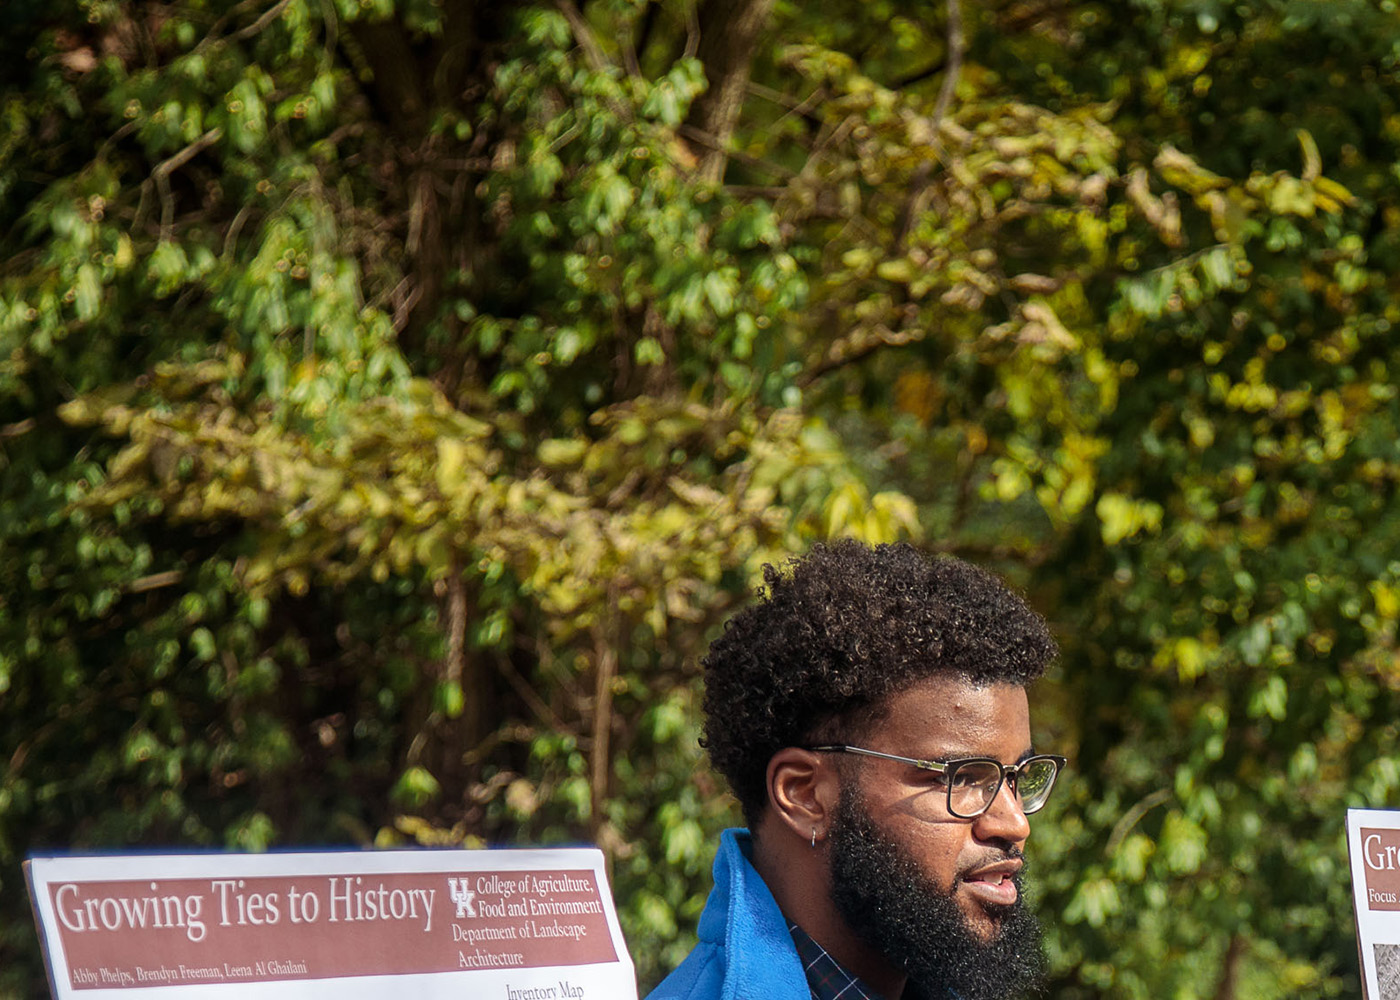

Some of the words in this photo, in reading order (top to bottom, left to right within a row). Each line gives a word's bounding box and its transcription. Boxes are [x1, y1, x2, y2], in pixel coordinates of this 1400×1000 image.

[476, 875, 516, 898] College
[518, 876, 530, 894] of
[531, 874, 594, 896] Agriculture,
[1368, 888, 1396, 903] Focus
[55, 882, 206, 942] Growing
[211, 880, 281, 926] Ties
[288, 885, 319, 924] to
[329, 876, 436, 932] History
[478, 900, 504, 918] Food
[507, 900, 527, 917] and
[531, 898, 602, 916] Environment
[451, 923, 517, 945] Department
[518, 919, 530, 938] of
[530, 919, 586, 940] Landscape
[458, 948, 523, 967] Architecture
[73, 969, 98, 985] Abby
[100, 968, 135, 985] Phelps,
[136, 965, 178, 983] Brendyn
[179, 964, 223, 980] Freeman,
[224, 963, 252, 977] Leena
[255, 961, 266, 976] Al
[558, 980, 584, 1000] Map
